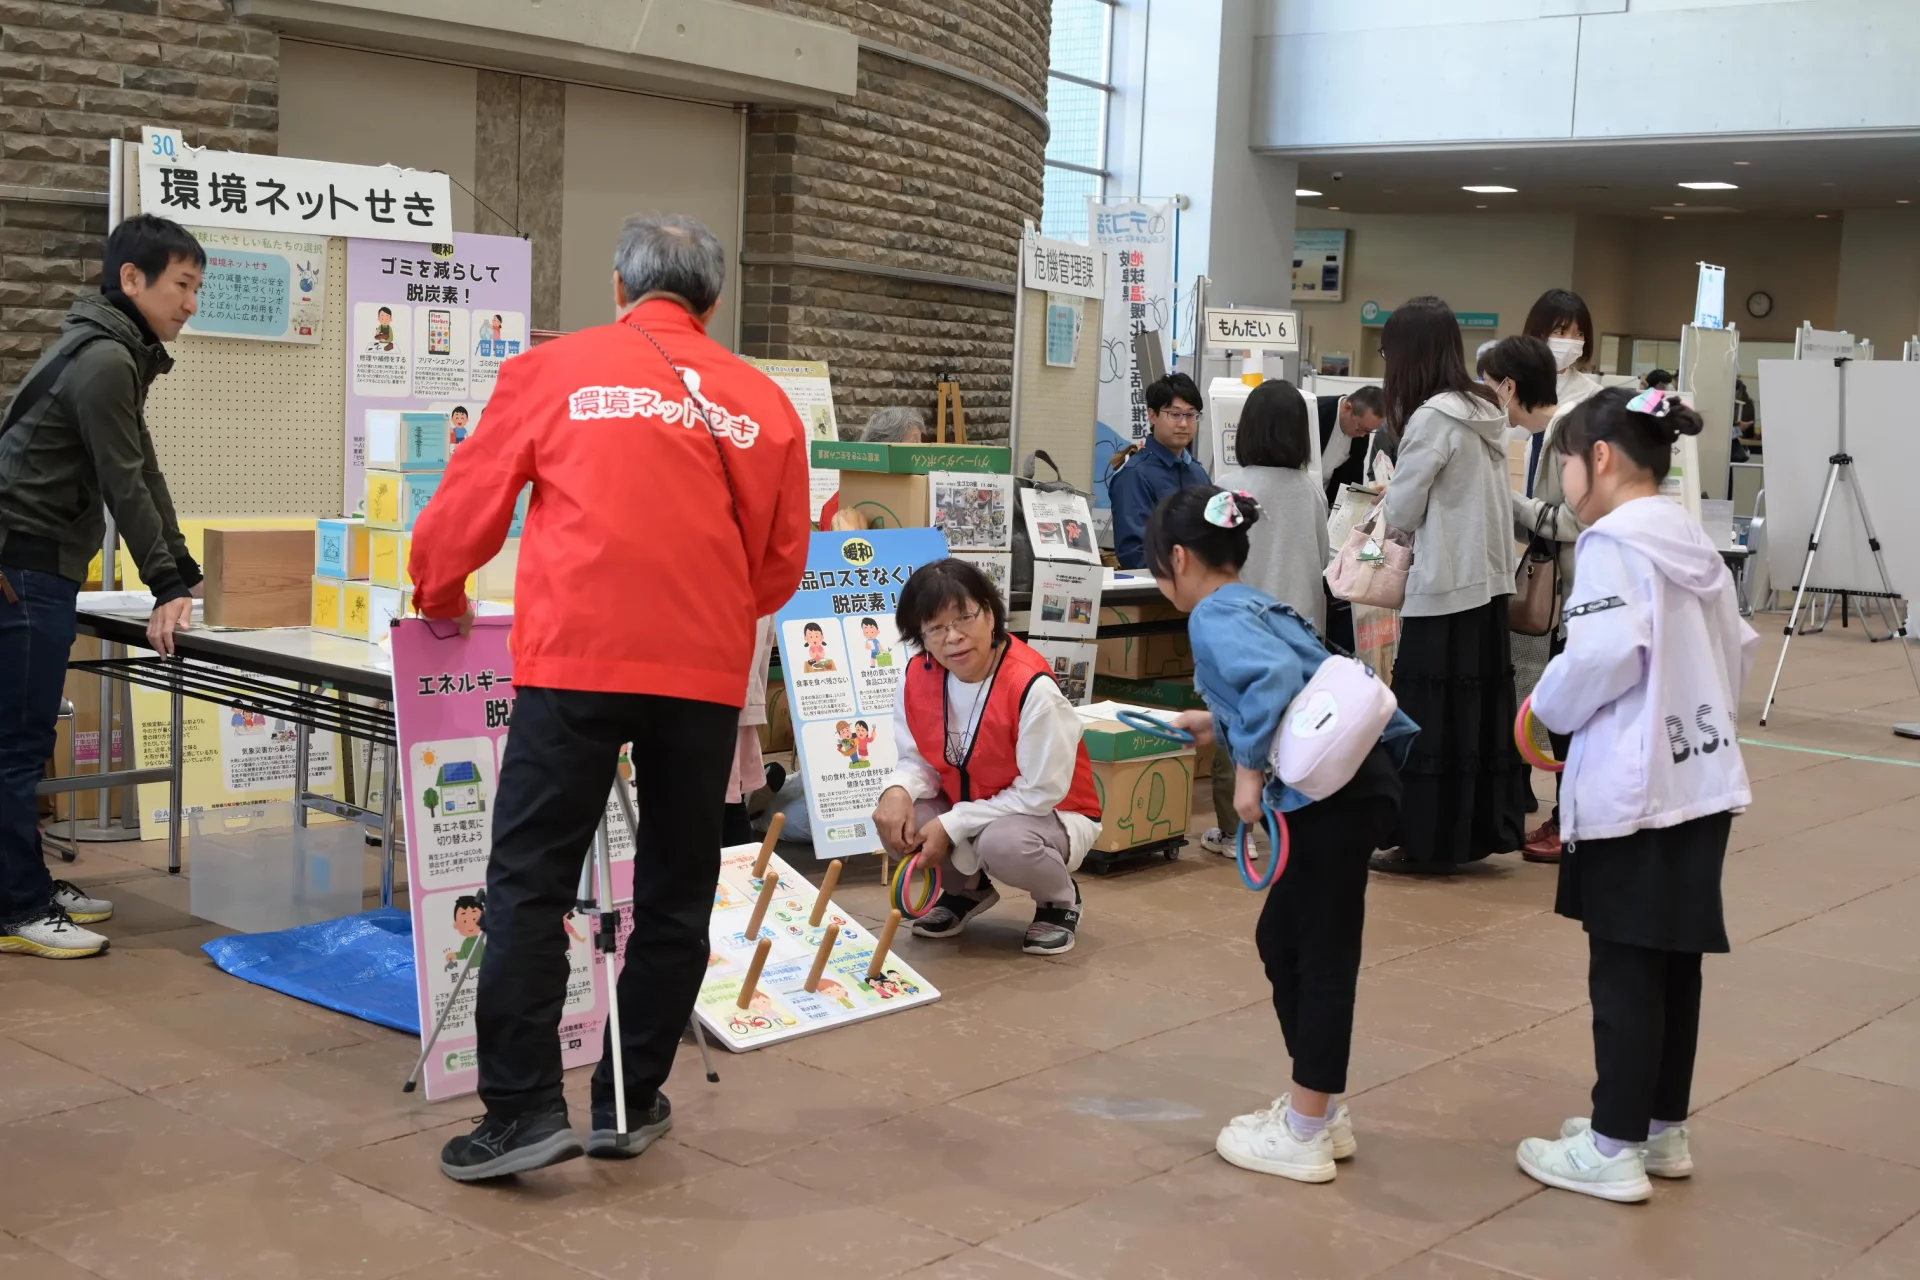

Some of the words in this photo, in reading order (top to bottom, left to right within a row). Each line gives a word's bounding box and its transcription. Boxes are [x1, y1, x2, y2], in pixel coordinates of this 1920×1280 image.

[151, 134, 174, 157] 30
[160, 167, 436, 228] 環境ネットせき
[209, 257, 268, 271] 環境ネットせき
[381, 257, 500, 283] ゴミを減らして
[1034, 246, 1095, 289] 危機管理課
[406, 283, 470, 304] 脱炭素！
[1218, 318, 1271, 338] もんだい
[1278, 321, 1287, 337] 6
[479, 360, 502, 368] ゴミの分
[571, 388, 757, 449] 環境ネットせき
[842, 542, 873, 562] 緩和
[796, 564, 913, 592] 品ロスをなく
[418, 669, 513, 696] エネルギー
[796, 677, 849, 687] 食事を食べ残さない
[484, 698, 515, 729] 脱
[433, 818, 484, 835] 再エネ電気に
[436, 830, 484, 847] 切り替えよう
